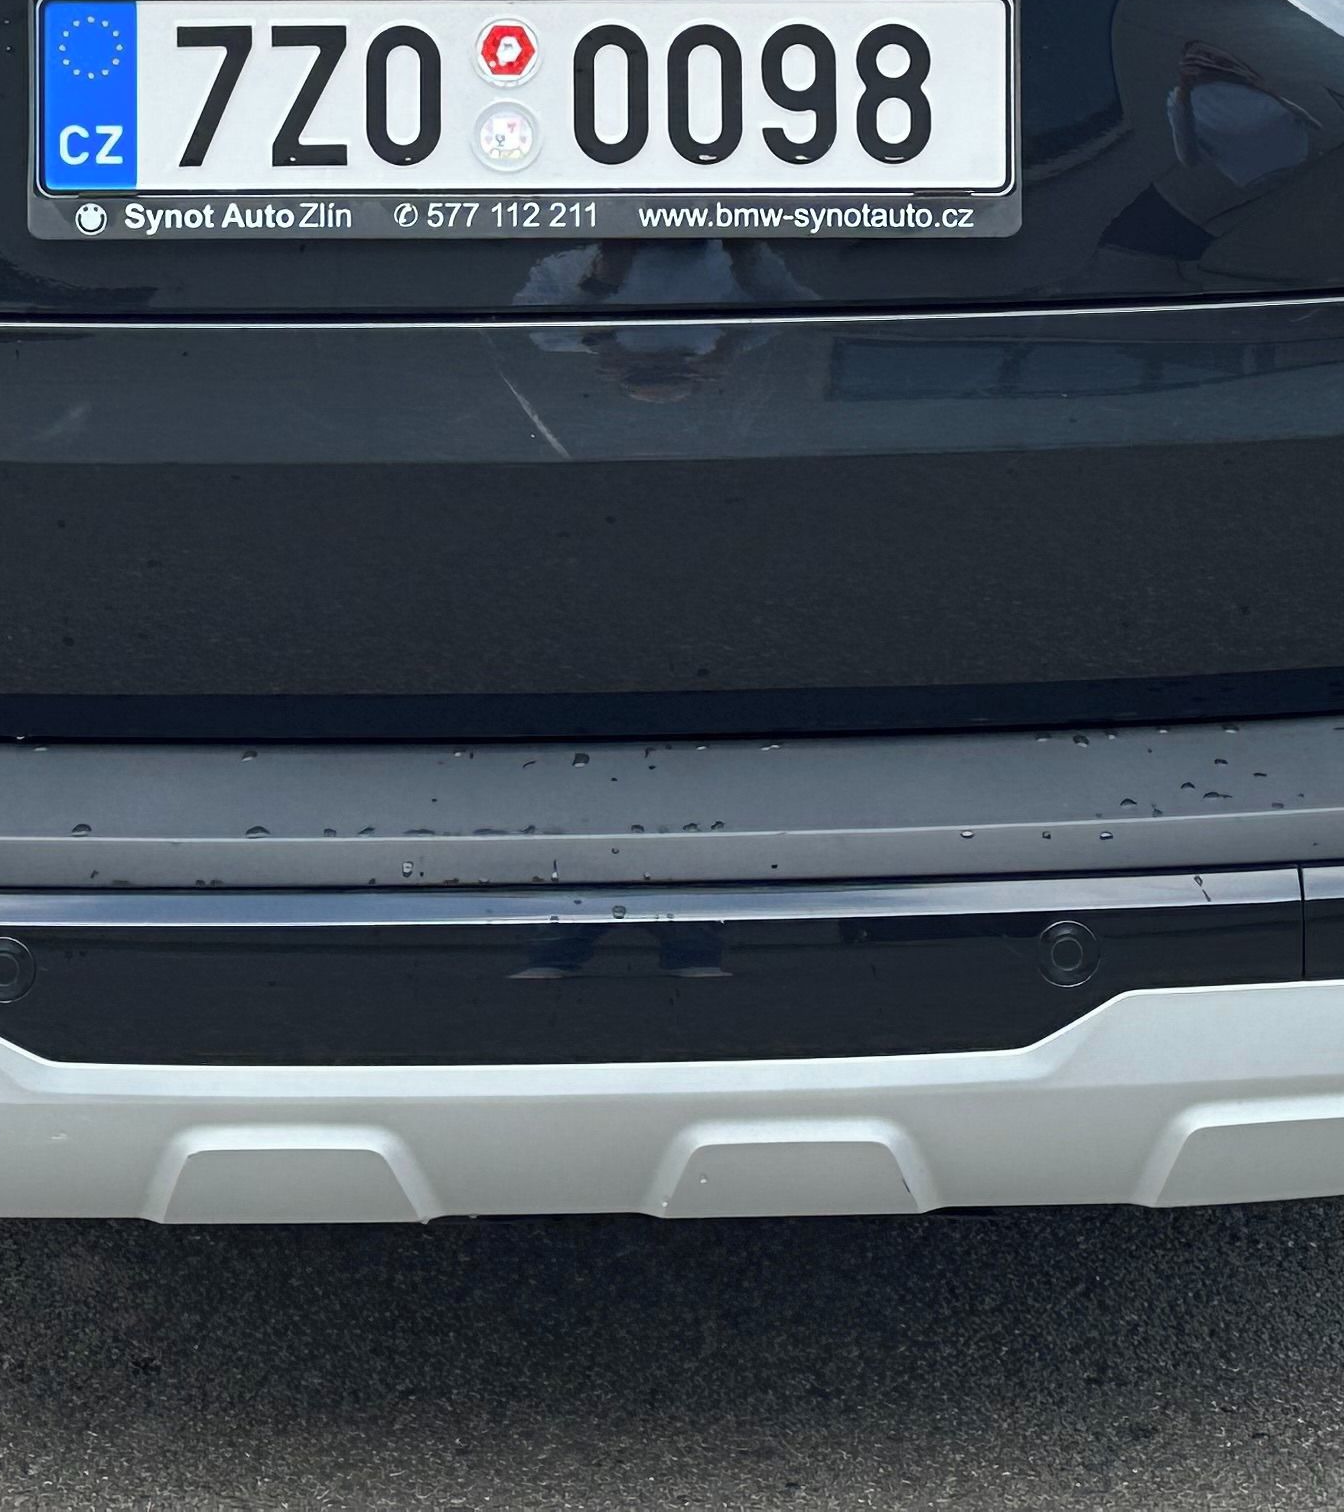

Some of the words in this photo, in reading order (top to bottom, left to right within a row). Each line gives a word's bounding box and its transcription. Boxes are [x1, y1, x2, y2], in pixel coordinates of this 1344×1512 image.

[174, 23, 442, 167] 7Z0
[571, 23, 932, 167] 0098
[59, 125, 124, 166] CZ
[124, 202, 214, 236] Synot
[221, 202, 295, 229] Auto
[298, 202, 353, 229] Zlín
[427, 202, 480, 228] 577
[491, 202, 540, 228] 112
[549, 202, 597, 228] 211
[638, 201, 975, 234] www.bmw-synotauto.cz
